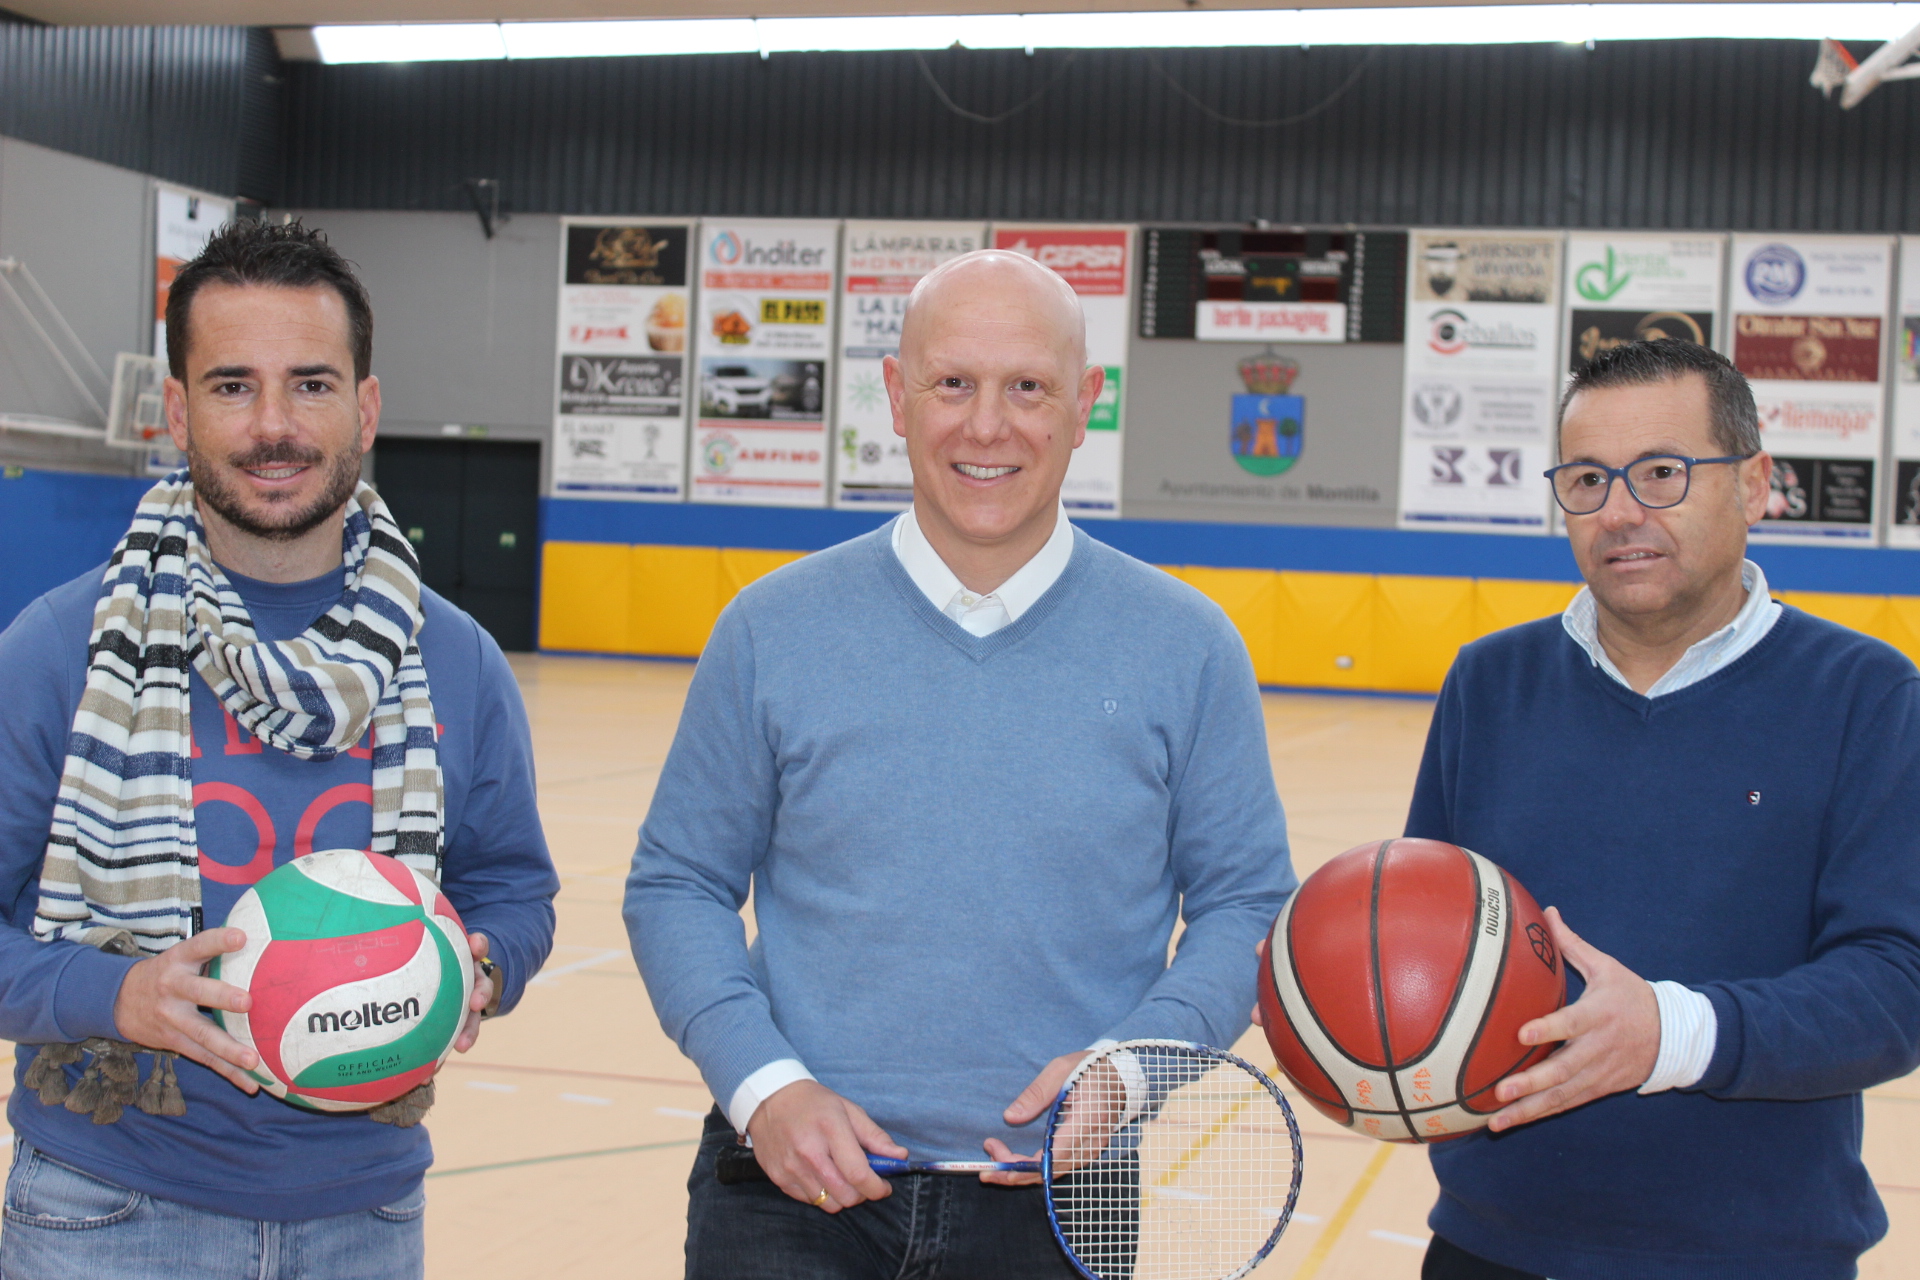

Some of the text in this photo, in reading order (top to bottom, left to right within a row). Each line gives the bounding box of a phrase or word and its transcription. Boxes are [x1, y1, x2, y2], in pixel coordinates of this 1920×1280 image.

[744, 239, 824, 265] Inditer
[850, 233, 974, 253] LÁMPARAS
[1040, 245, 1123, 268] CEPSA
[764, 303, 779, 319] EL
[859, 298, 884, 314] LA
[1160, 479, 1274, 499] Ayuntamiento
[1307, 484, 1381, 501] Montilla
[1485, 886, 1500, 937] BG3000
[308, 996, 420, 1034] molten
[337, 1053, 403, 1071] OFFICIAL
